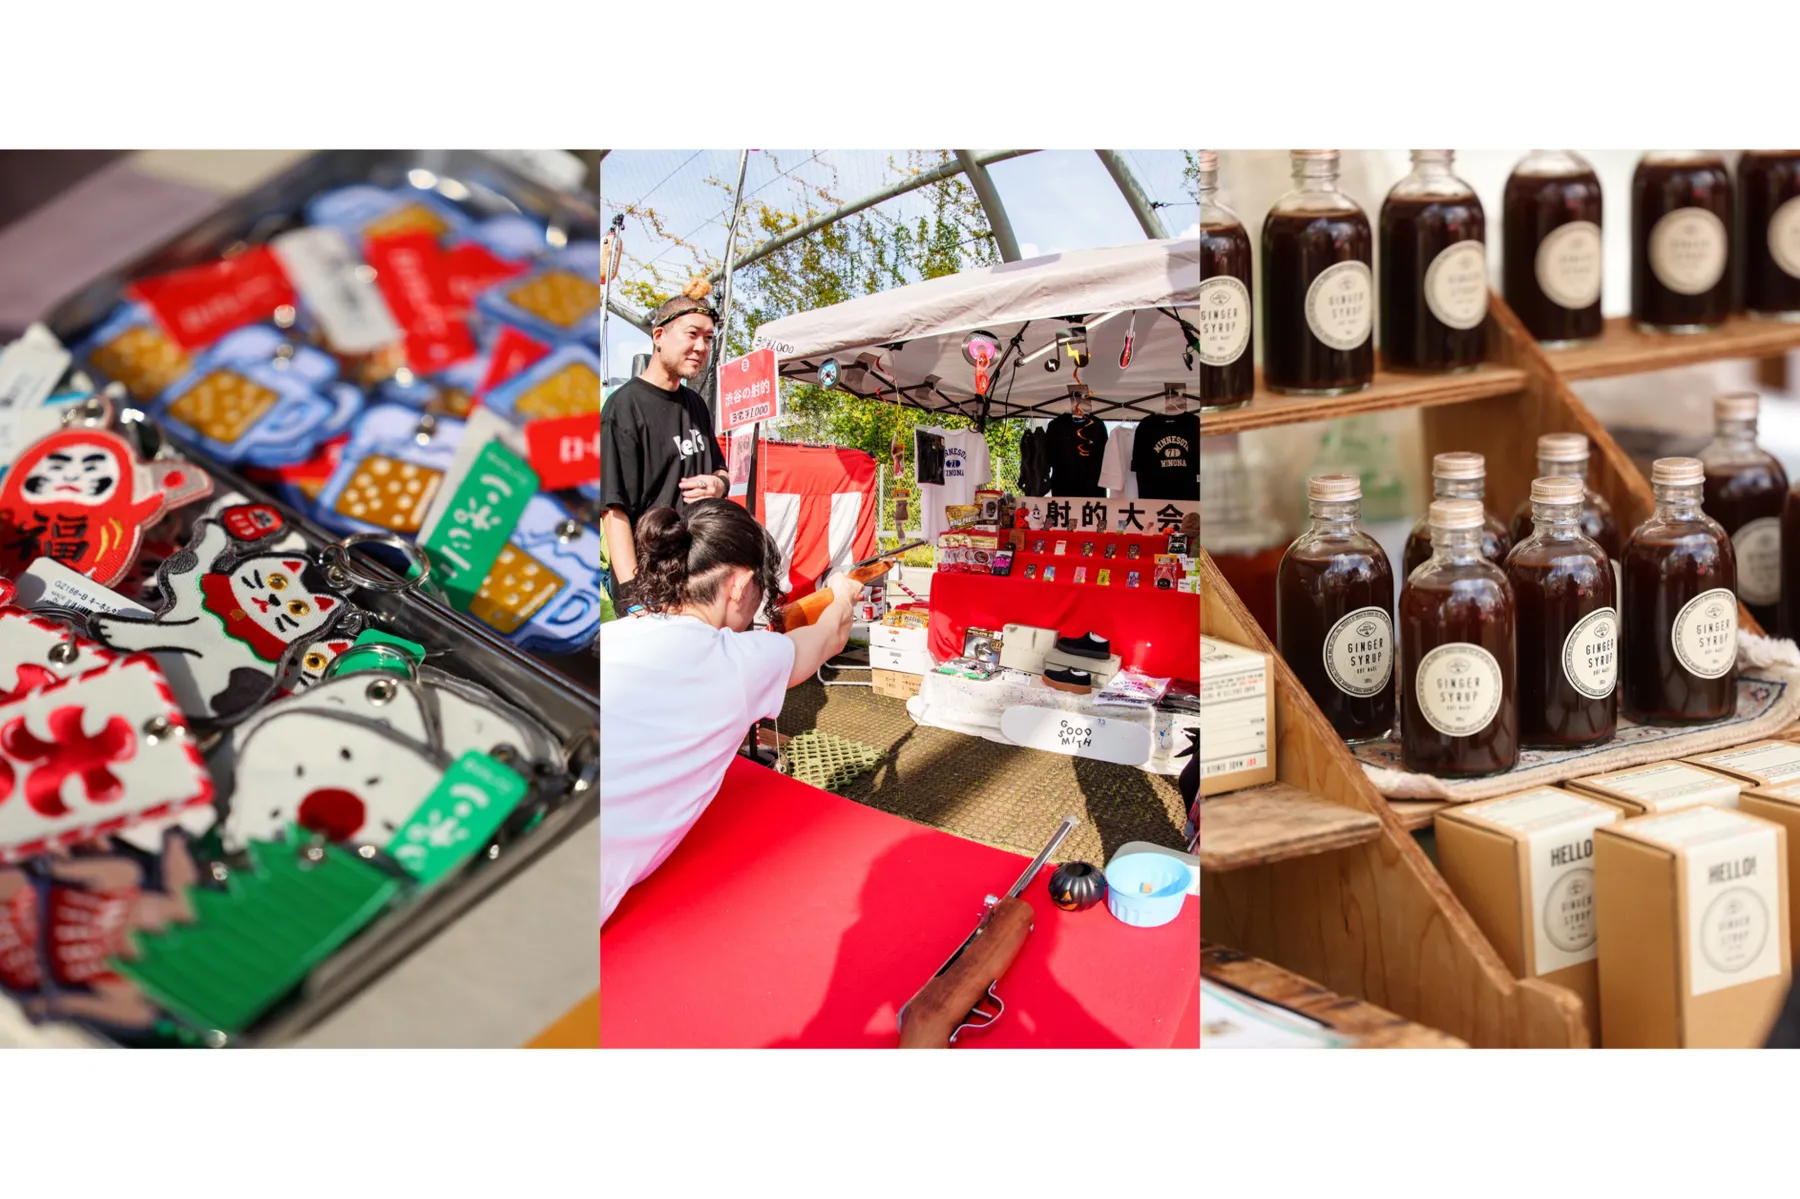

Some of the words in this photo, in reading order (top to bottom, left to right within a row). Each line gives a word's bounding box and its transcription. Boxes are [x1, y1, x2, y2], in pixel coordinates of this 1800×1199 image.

[1201, 308, 1238, 321] GINGER
[1203, 321, 1236, 333] SYRUP
[725, 378, 770, 407] 渋谷の射的
[1046, 500, 1184, 532] 射的大会
[4, 510, 89, 562] 福
[1696, 619, 1730, 635] GINGER
[1347, 638, 1383, 653] GINGER
[1585, 638, 1614, 655] GINGER
[1699, 633, 1729, 648] SYRUP
[1350, 652, 1382, 667] SYRUP
[1588, 653, 1613, 668] SYRUP
[1436, 677, 1481, 689] GINGER
[1440, 691, 1478, 703] SYRUP
[1060, 719, 1092, 737] GOOD
[1057, 729, 1092, 748] SMITH
[1550, 839, 1593, 867] HELLO
[1708, 855, 1757, 885] HELLO!
